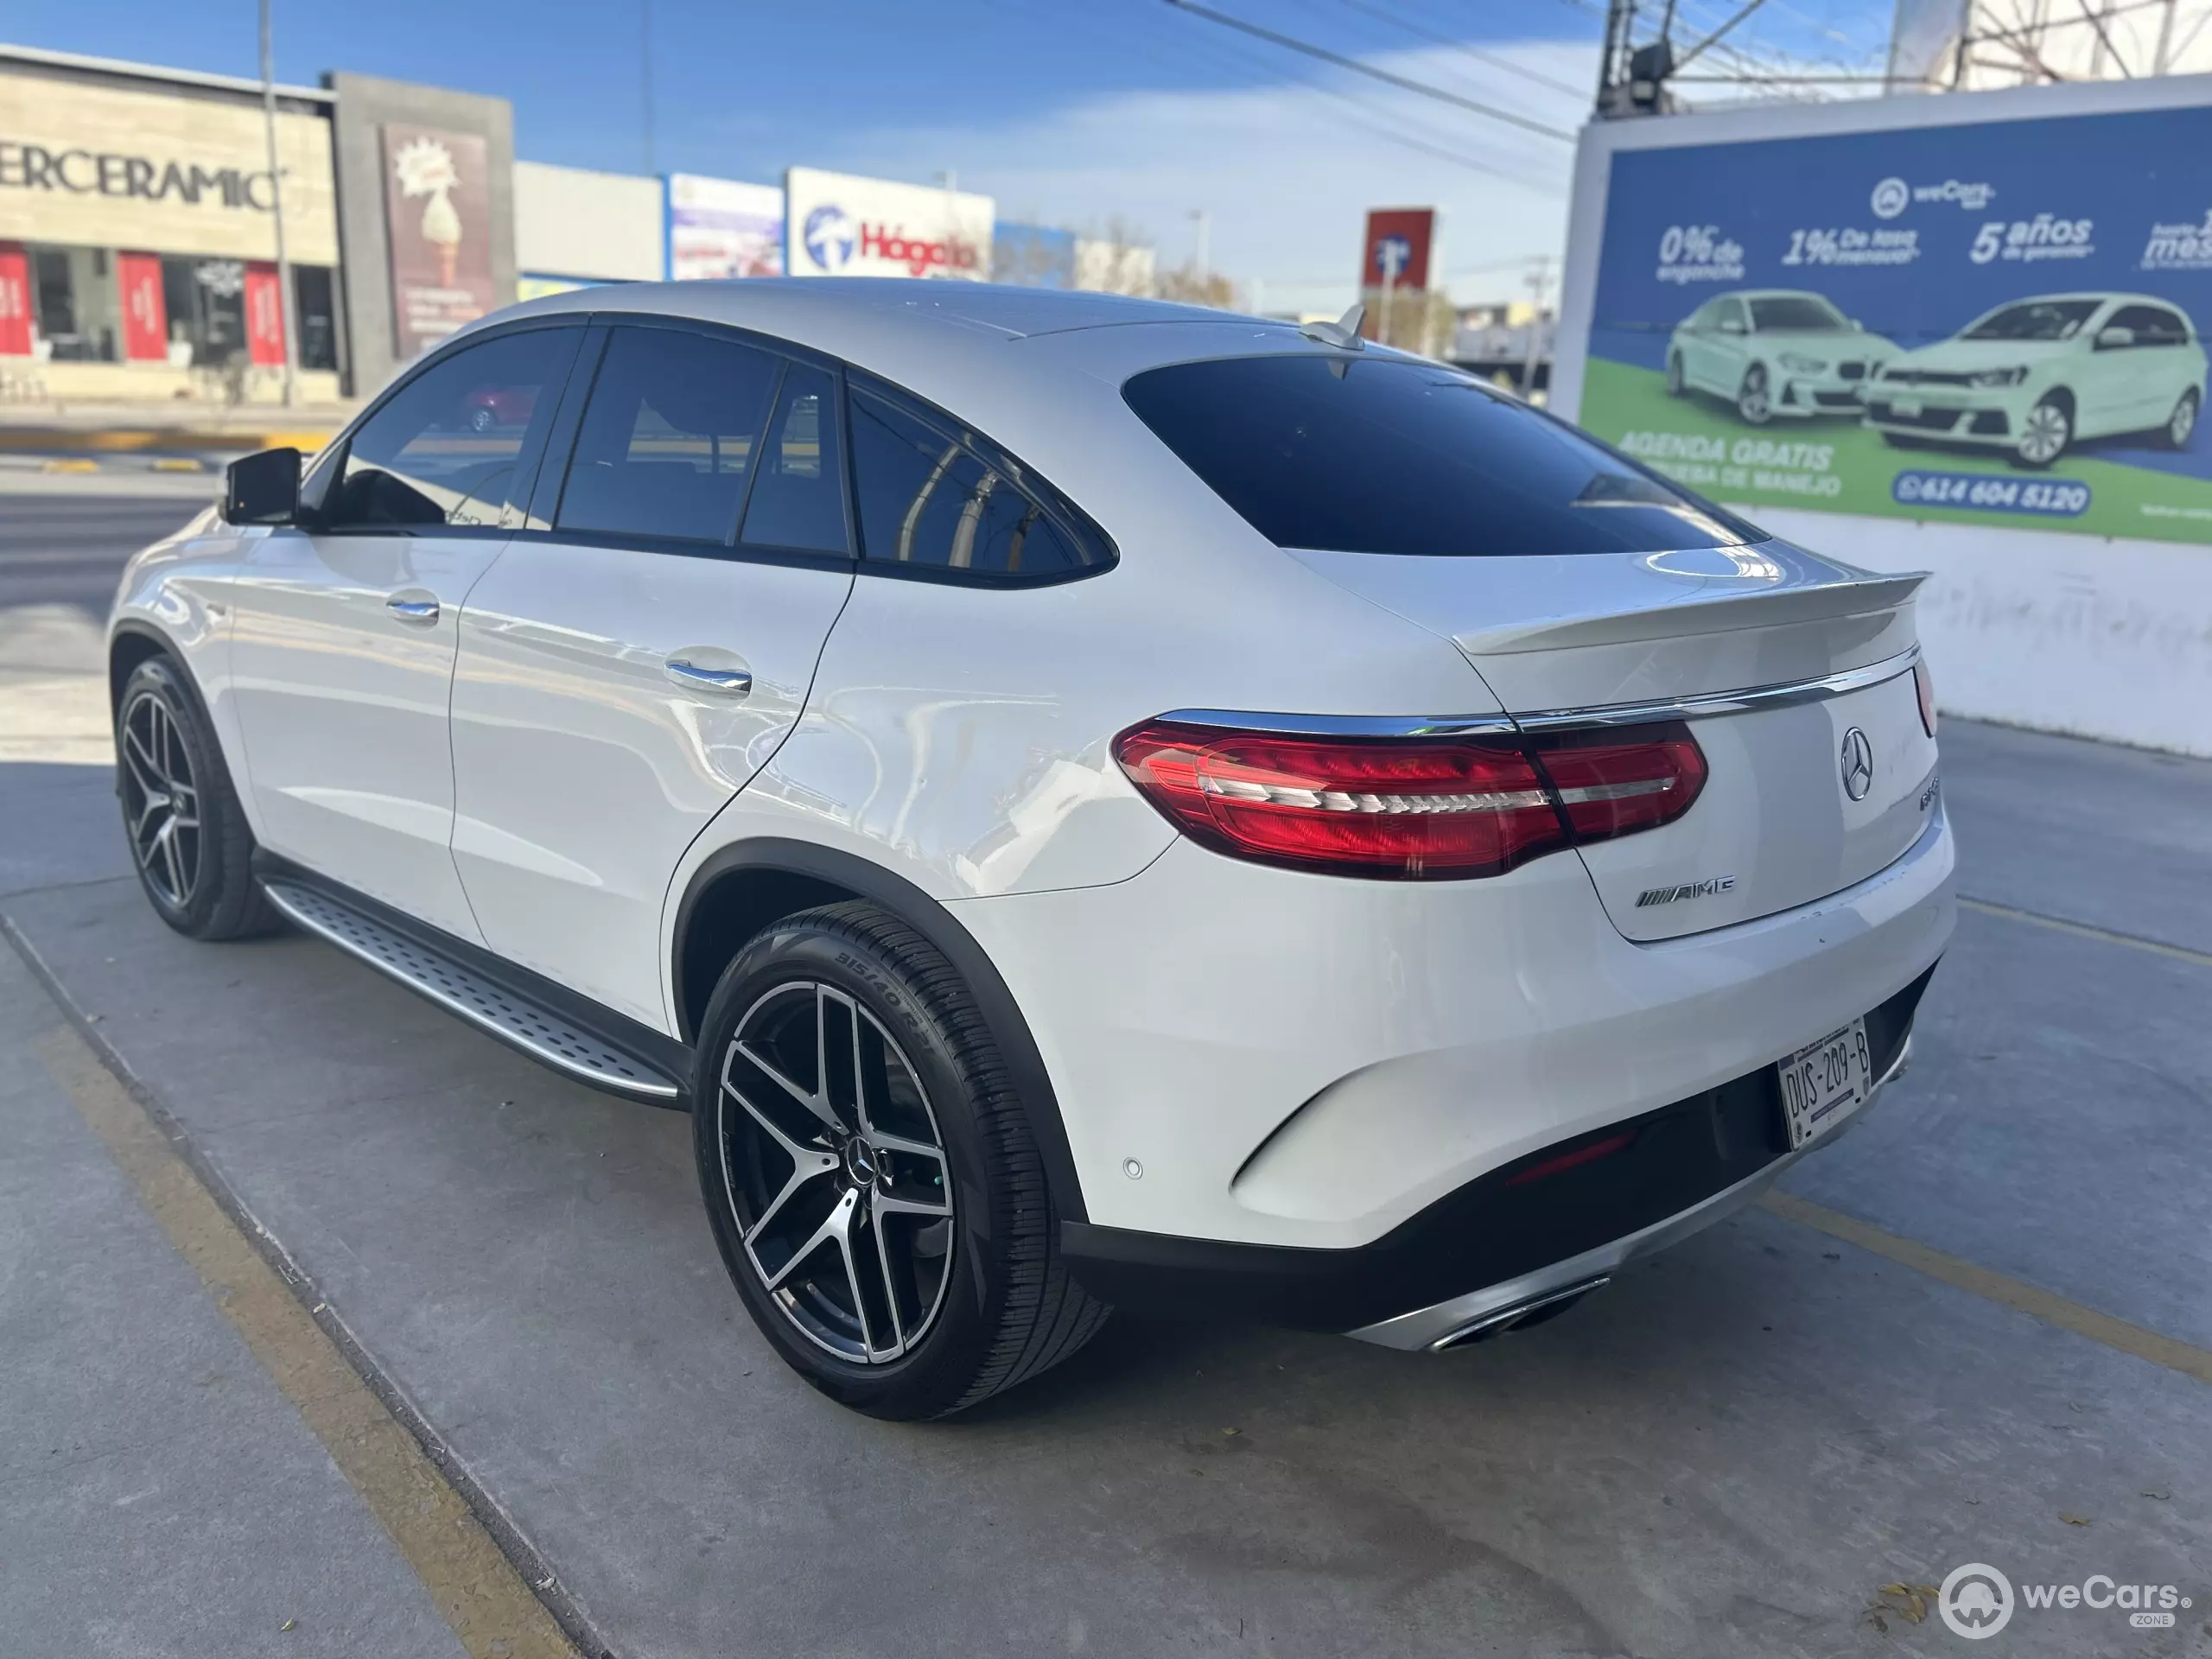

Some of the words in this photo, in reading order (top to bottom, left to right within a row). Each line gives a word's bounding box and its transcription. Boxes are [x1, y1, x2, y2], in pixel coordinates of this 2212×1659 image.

[1969, 221, 2006, 264] 5
[2005, 213, 2093, 245] años
[1732, 438, 1834, 471] GRATIS
[1920, 477, 1968, 503] 614
[1969, 480, 2020, 506] 604
[2020, 484, 2088, 512] 5120
[1668, 875, 1736, 903] AMG
[1786, 1031, 1869, 1118] DUS-209-B
